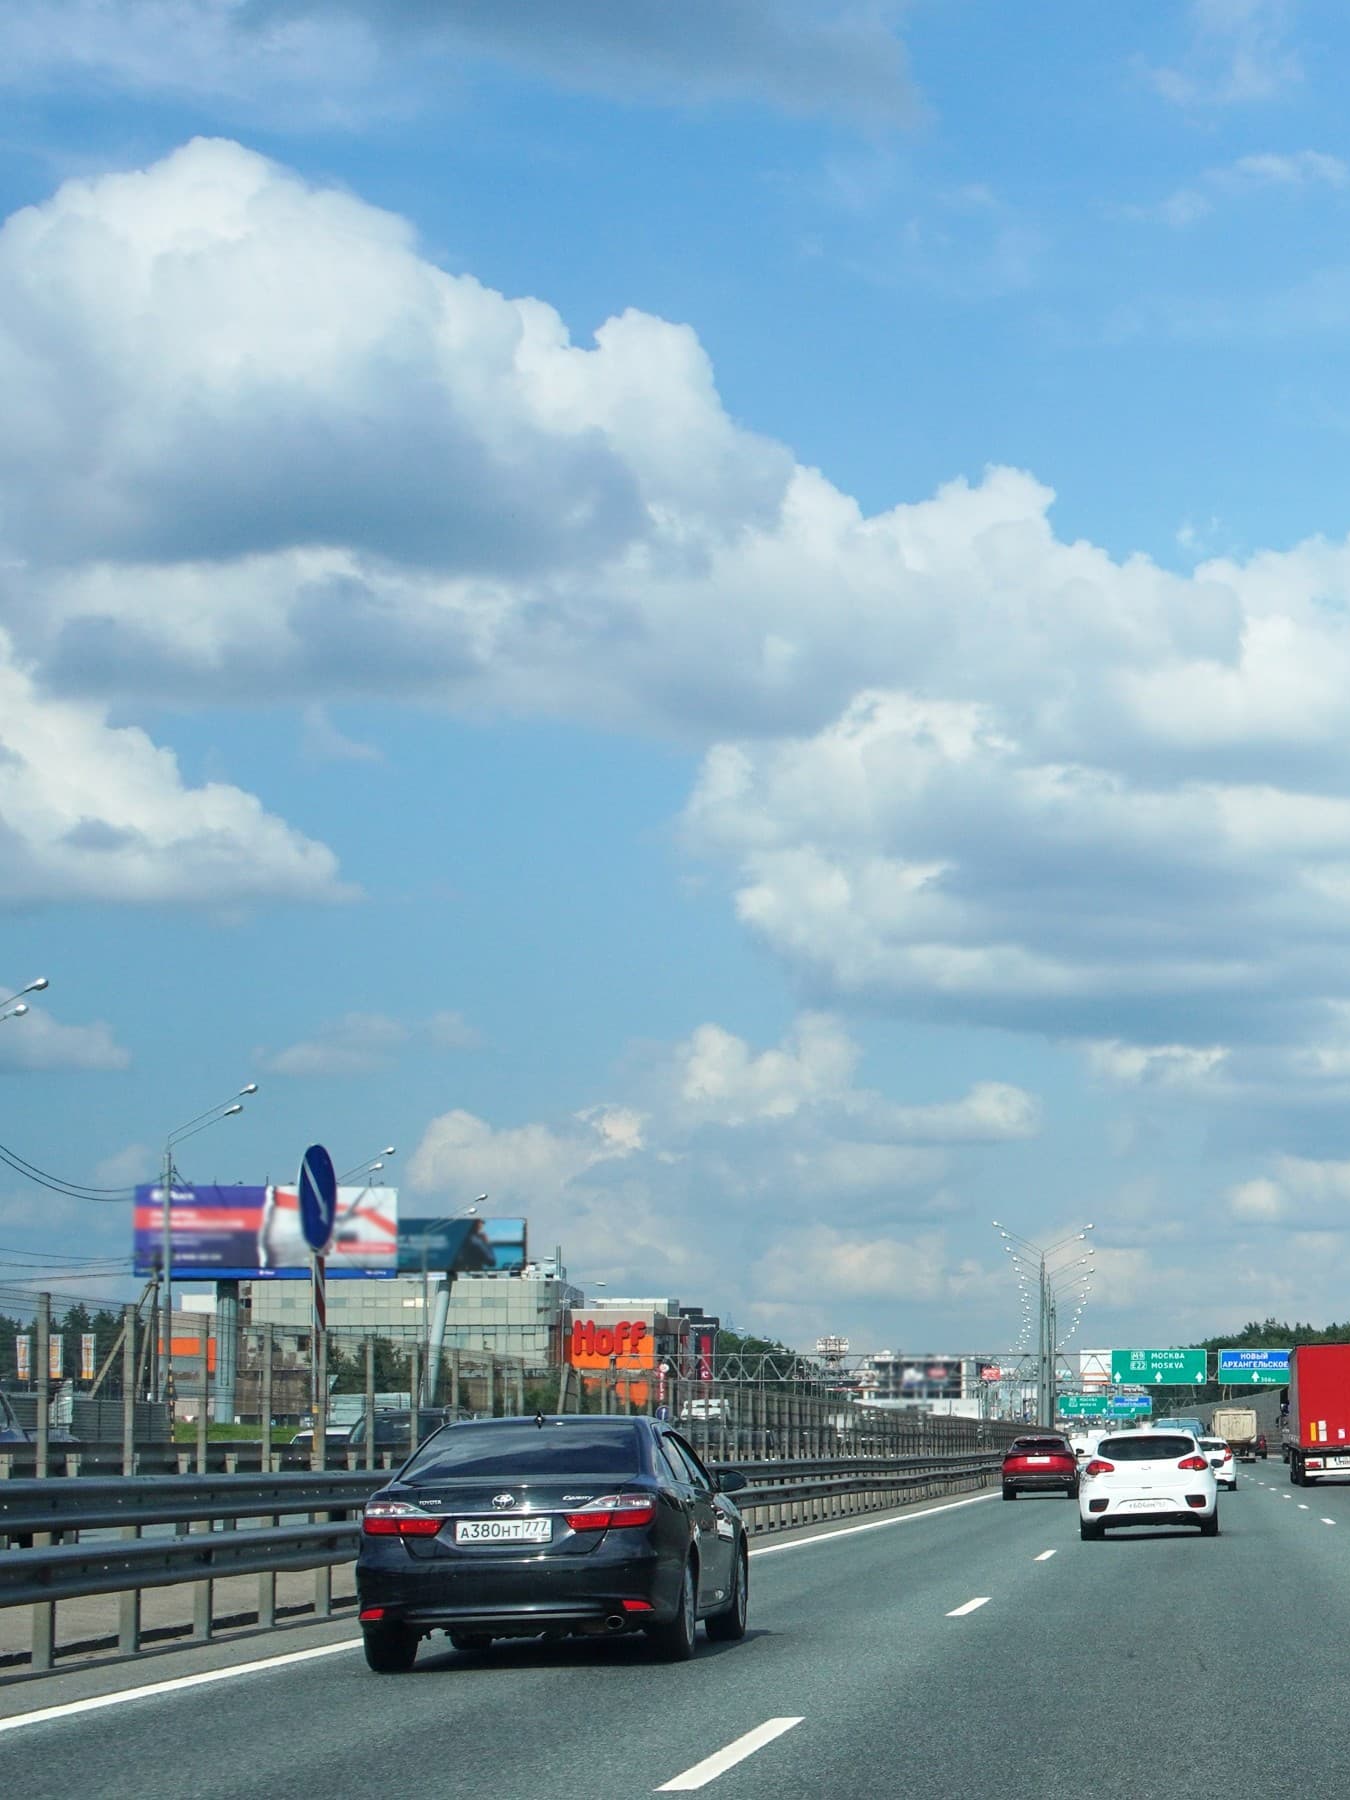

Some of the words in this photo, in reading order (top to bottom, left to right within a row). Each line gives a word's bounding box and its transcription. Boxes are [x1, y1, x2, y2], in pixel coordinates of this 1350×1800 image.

[573, 1320, 646, 1356] Hoff
[1151, 1352, 1185, 1360] МОСКВА
[1240, 1352, 1268, 1360] НОВЫЙ
[1151, 1361, 1184, 1369] MOSKVA
[1222, 1361, 1289, 1369] АРХАНГЕЛЬСКОЕ
